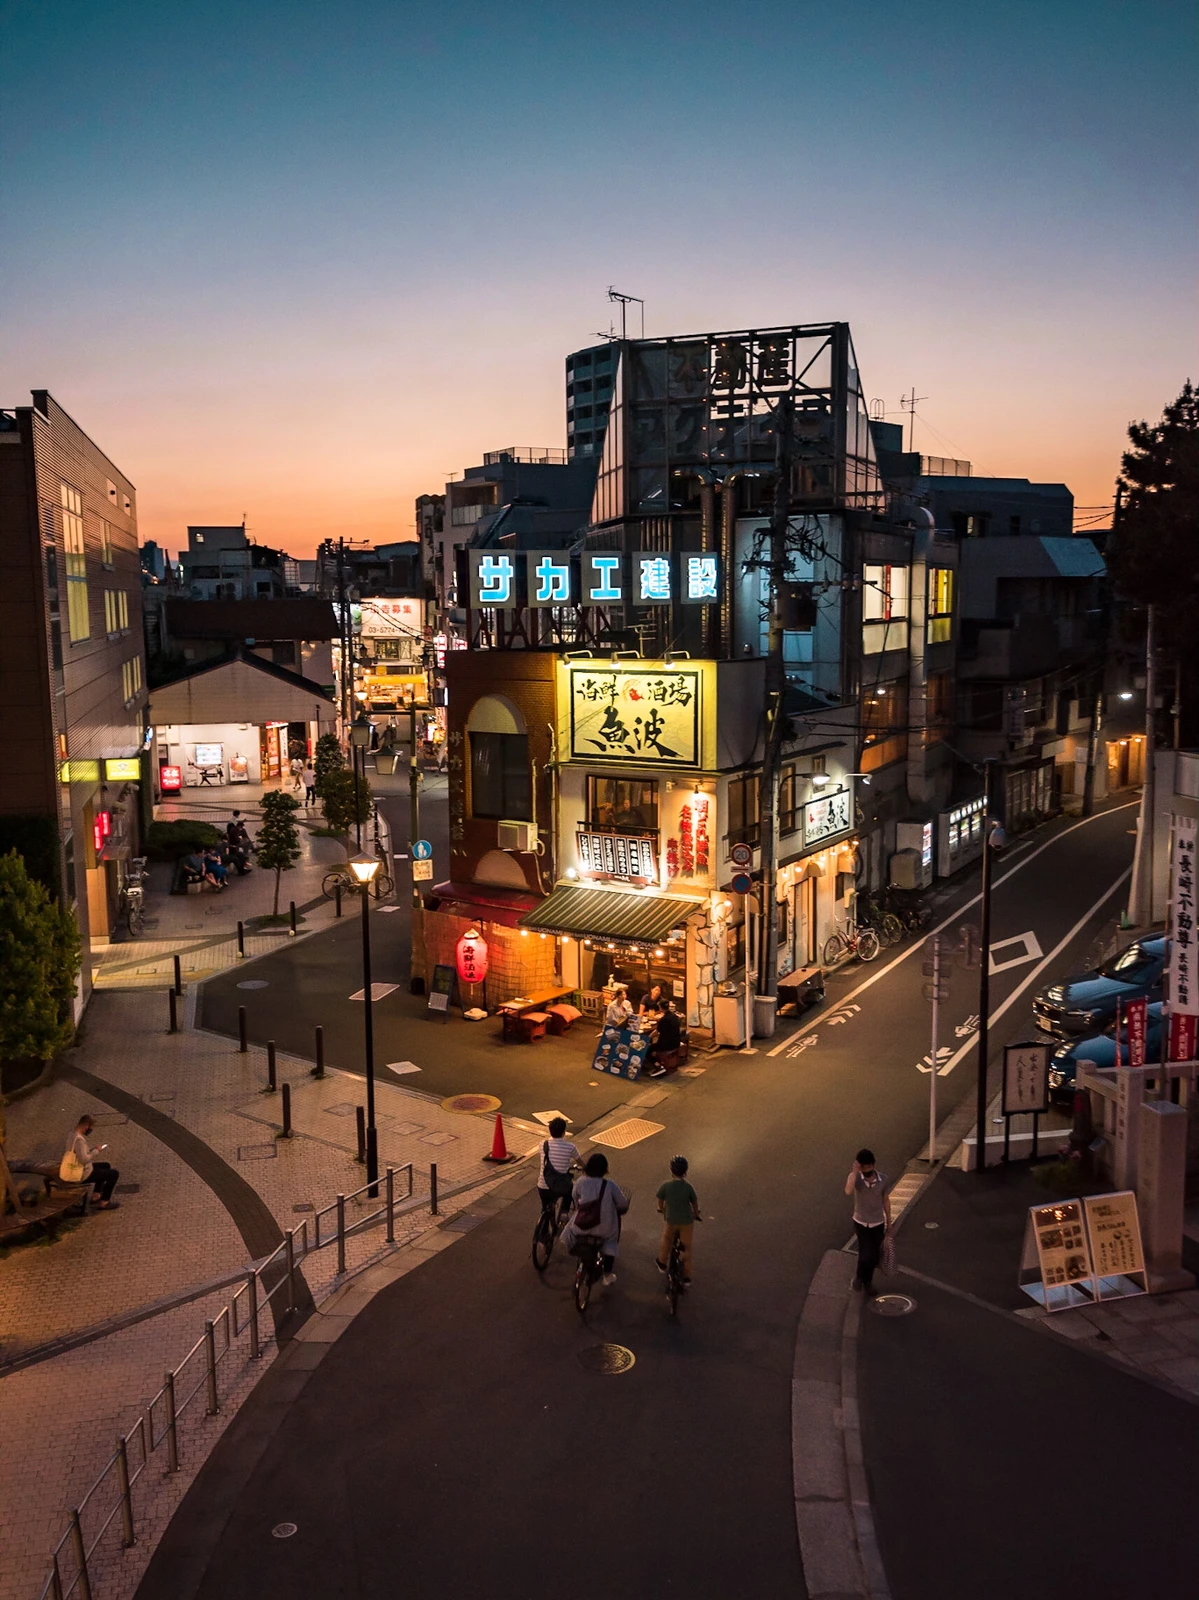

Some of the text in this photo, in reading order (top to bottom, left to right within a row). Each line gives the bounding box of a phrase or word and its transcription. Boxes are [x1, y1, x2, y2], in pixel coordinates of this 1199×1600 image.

[576, 674, 692, 707] 海鮮 酒場
[583, 705, 684, 758] 魚波
[735, 850, 747, 859] 20
